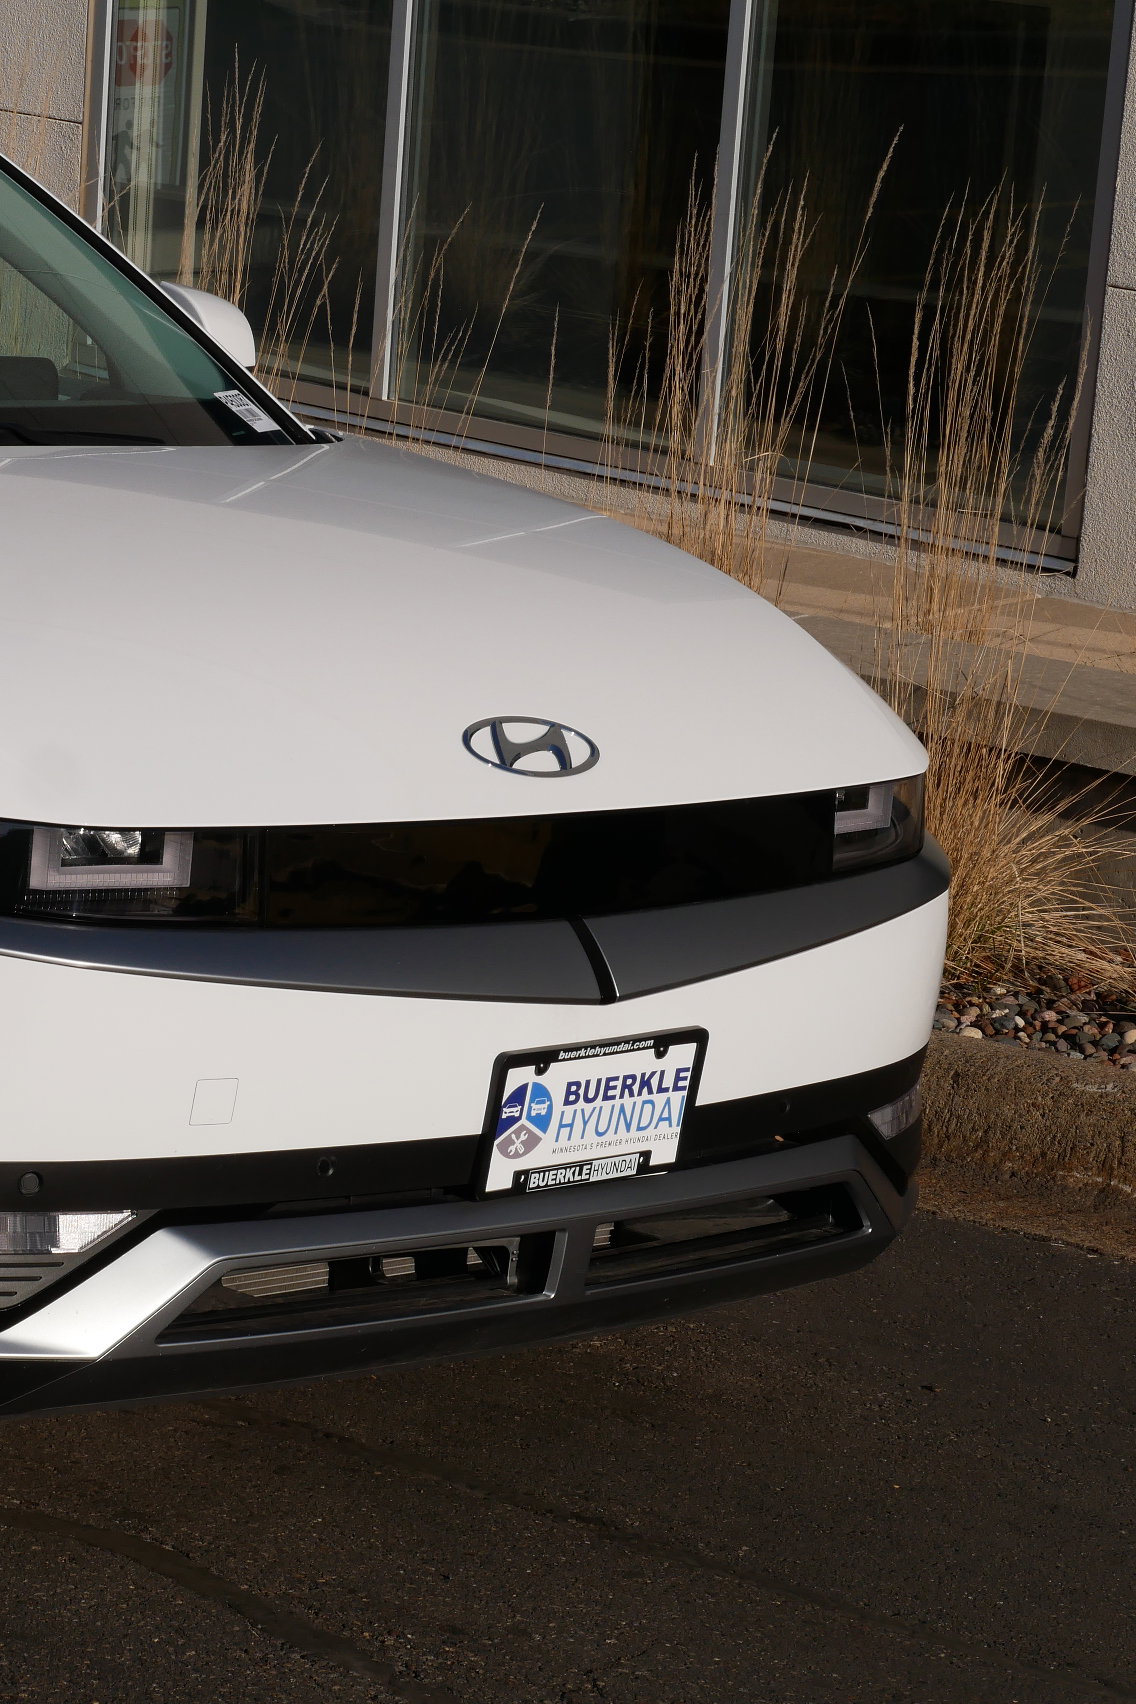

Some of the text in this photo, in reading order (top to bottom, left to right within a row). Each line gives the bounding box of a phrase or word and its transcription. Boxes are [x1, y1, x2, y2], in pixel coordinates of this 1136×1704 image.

[558, 1039, 655, 1060] buerklehyundai.com
[562, 1066, 691, 1107] BUERKLE
[554, 1095, 686, 1143] HYUNDAI
[552, 1131, 679, 1155] MINNESOTA'S PREMIER HYUNDAI DEALER
[529, 1157, 637, 1189] BUERKLE HYUNDAI
